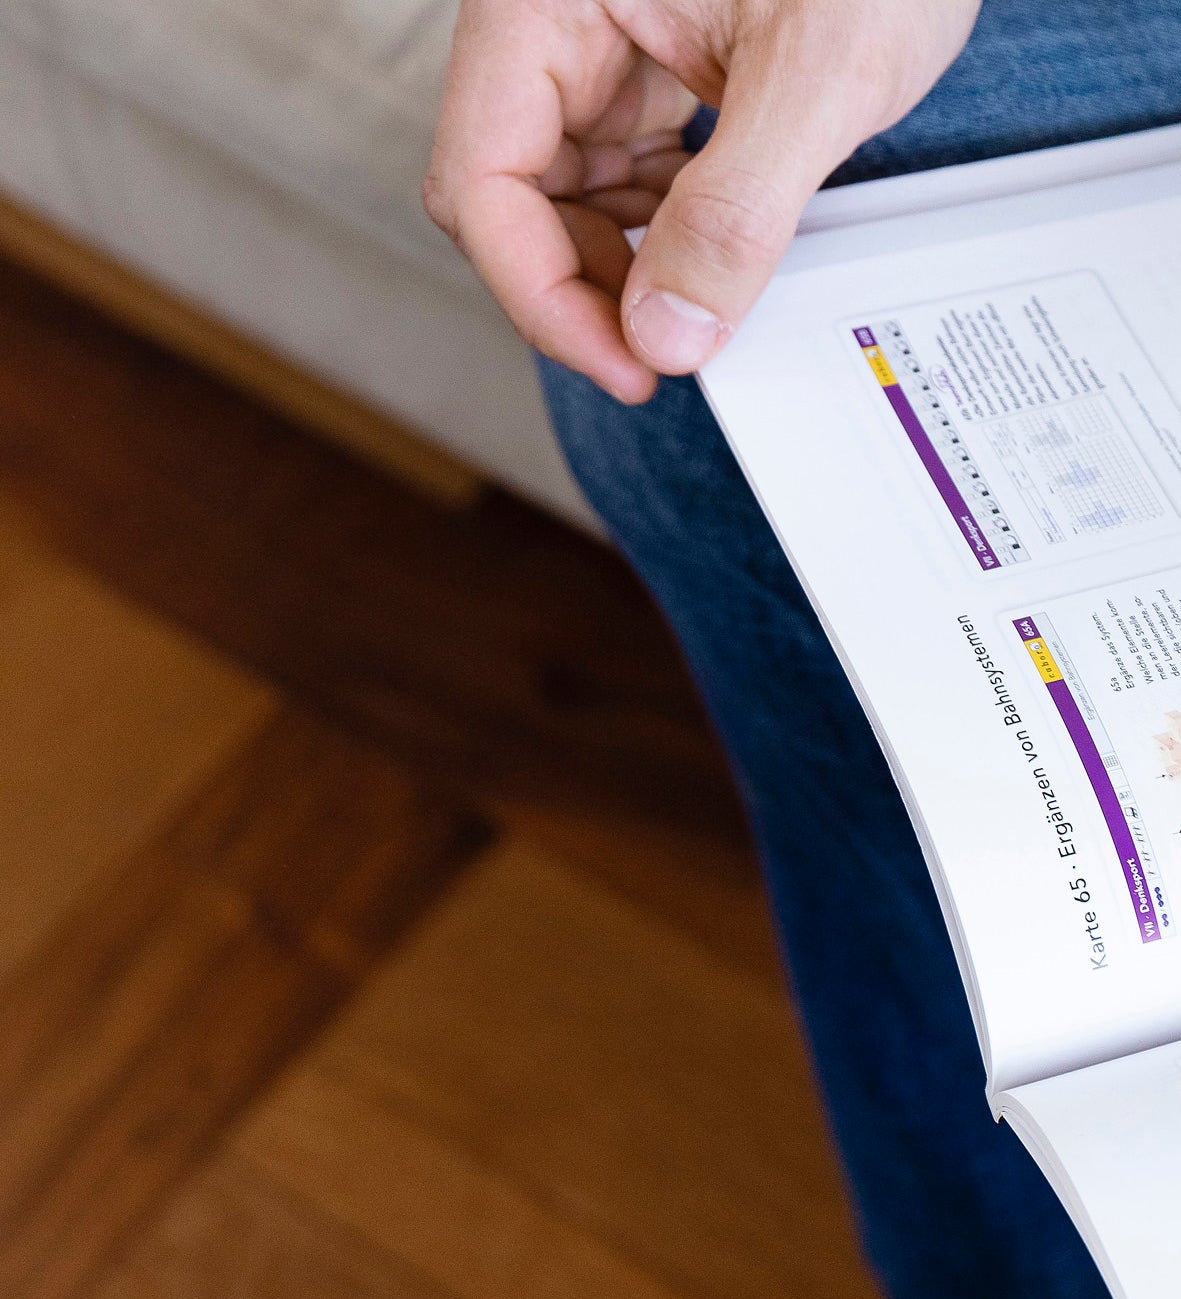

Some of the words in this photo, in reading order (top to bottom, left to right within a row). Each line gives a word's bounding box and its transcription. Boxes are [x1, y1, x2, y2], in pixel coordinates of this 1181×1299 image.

[1155, 588, 1171, 604] und
[1019, 620, 1035, 637] 65A
[1091, 611, 1111, 642] System.
[1128, 615, 1145, 637] Stelle
[1151, 602, 1177, 641] sichtbaren
[1106, 641, 1119, 656] das
[1116, 618, 1140, 654] Elemente
[1141, 637, 1152, 650] die
[1148, 651, 1159, 661] an
[956, 614, 1023, 727] Bahnsystemen
[1114, 657, 1136, 690] Ergänze
[1135, 654, 1155, 685] Welche
[1154, 662, 1168, 681] men
[1168, 663, 1181, 677] der
[1110, 676, 1122, 692] 65a
[1016, 729, 1038, 763] von
[1032, 767, 1077, 859] Ergänzen
[1068, 877, 1091, 903] 65
[1126, 857, 1151, 914] Denksport
[1084, 911, 1109, 969] Karte
[1142, 921, 1160, 941] VII
